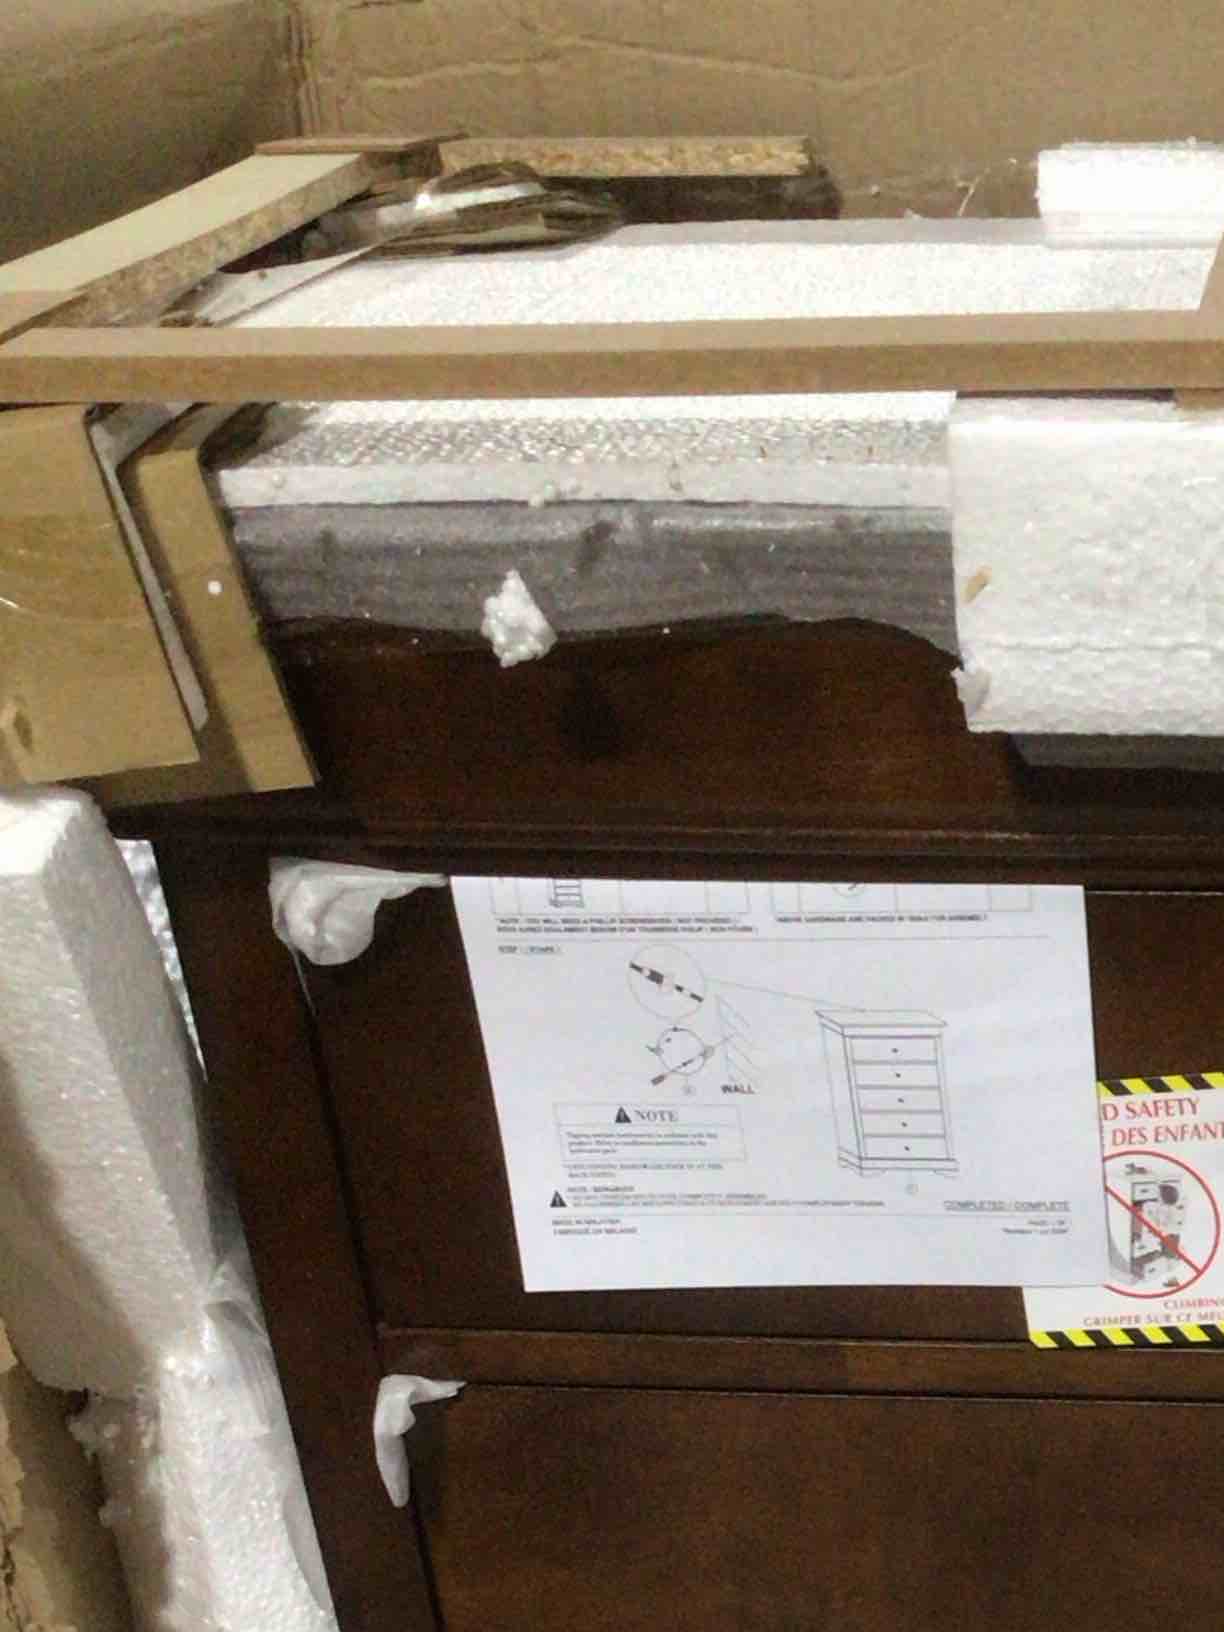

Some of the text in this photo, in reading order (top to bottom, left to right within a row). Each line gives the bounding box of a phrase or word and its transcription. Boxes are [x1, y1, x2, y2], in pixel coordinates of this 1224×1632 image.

[721, 1084, 755, 1095] WALL
[633, 1109, 679, 1122] NOTE
[1125, 1097, 1201, 1119] SAFETY
[1112, 1127, 1149, 1146] DES
[1083, 1314, 1141, 1327] GRIMPER
[1145, 1312, 1171, 1324] SUR
[1175, 1311, 1192, 1322] CE
